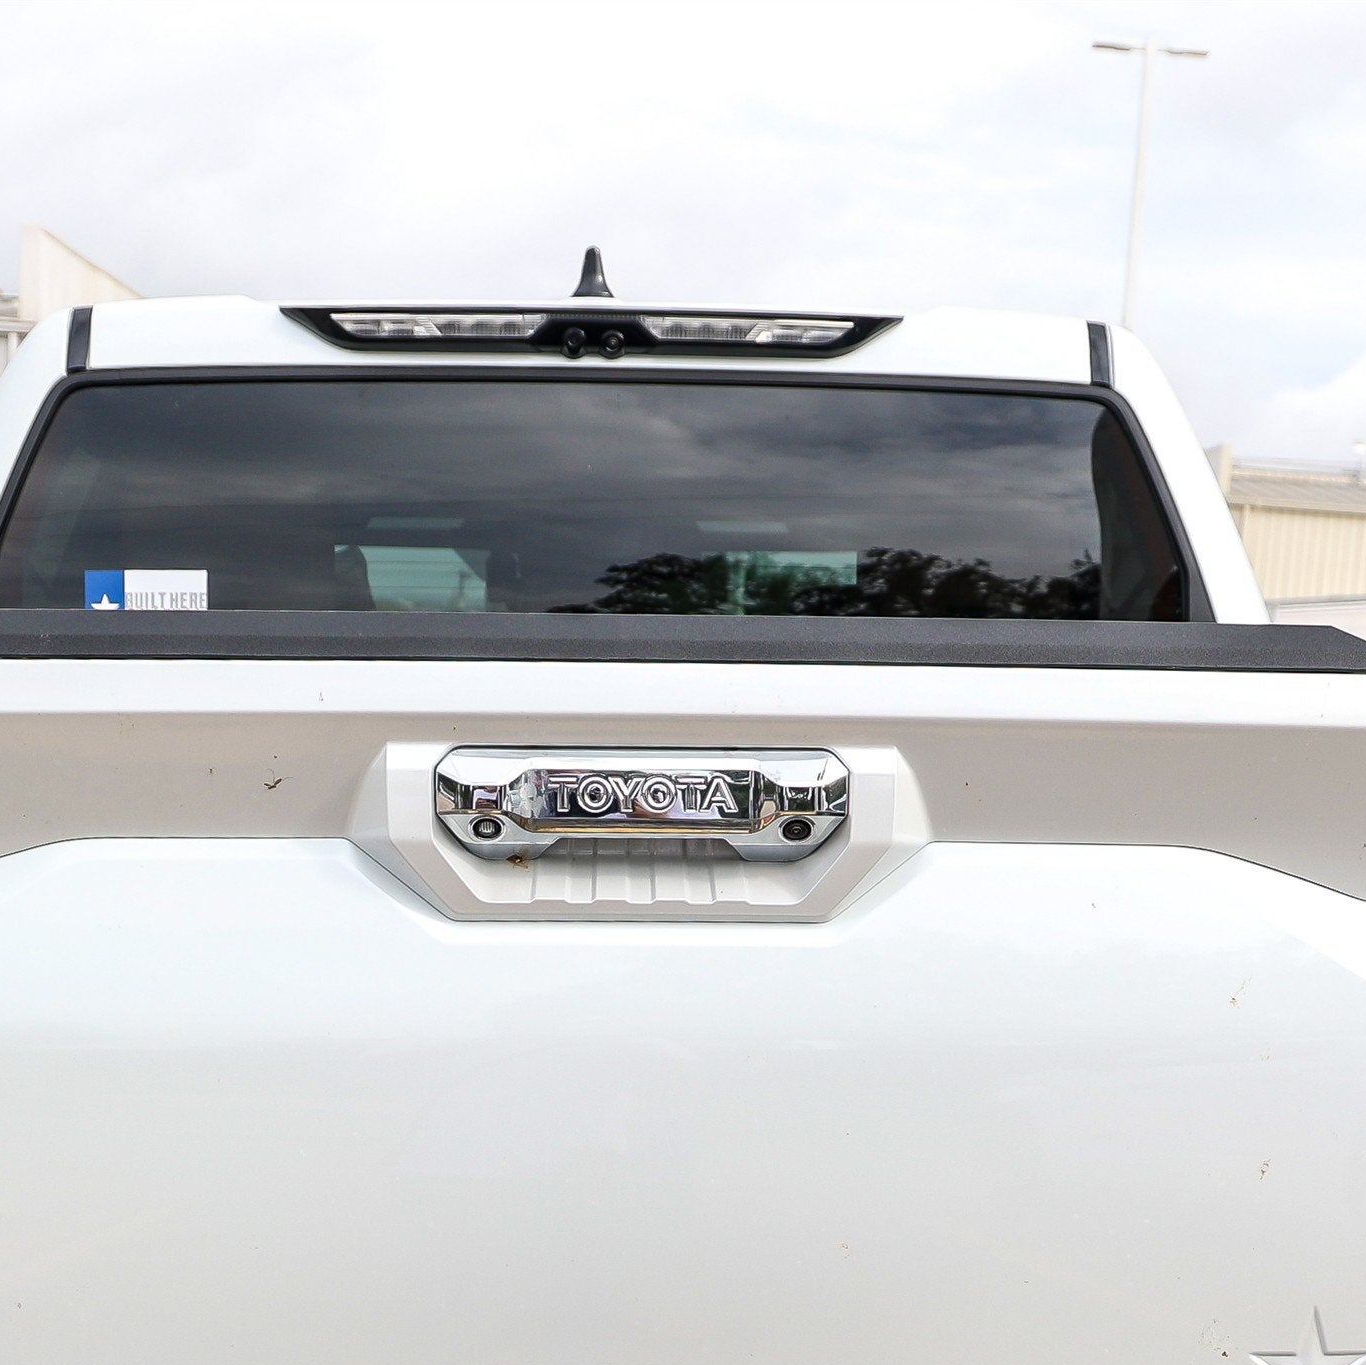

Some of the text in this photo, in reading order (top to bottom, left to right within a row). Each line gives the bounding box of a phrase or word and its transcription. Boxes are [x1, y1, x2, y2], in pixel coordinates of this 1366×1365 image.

[125, 592, 206, 609] BUILT HERE
[546, 774, 739, 814] TOYOTA
